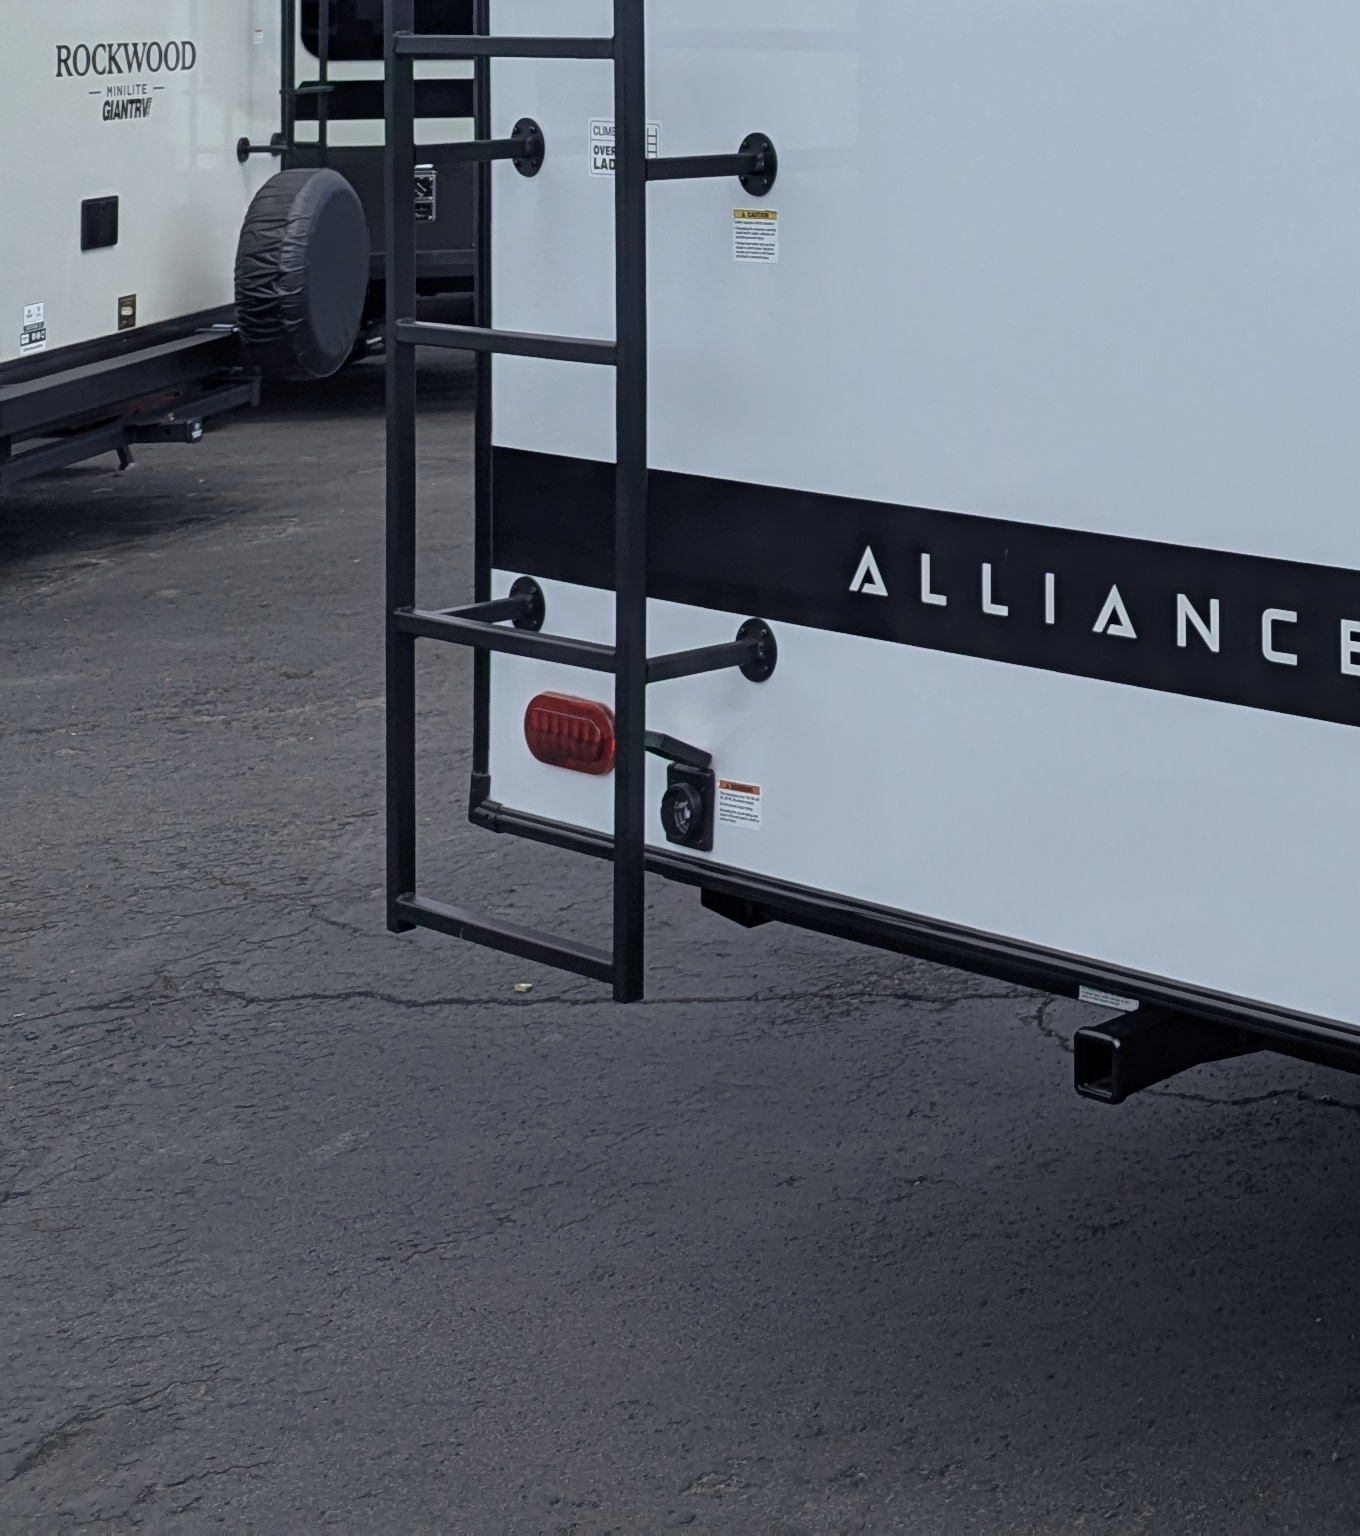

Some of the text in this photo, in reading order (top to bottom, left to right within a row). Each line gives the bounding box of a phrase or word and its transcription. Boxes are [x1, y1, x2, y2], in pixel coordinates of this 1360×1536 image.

[55, 41, 196, 77] ROCKWOOD
[106, 84, 148, 97] MINILITE
[593, 145, 616, 156] OVER
[593, 157, 616, 170] LAD
